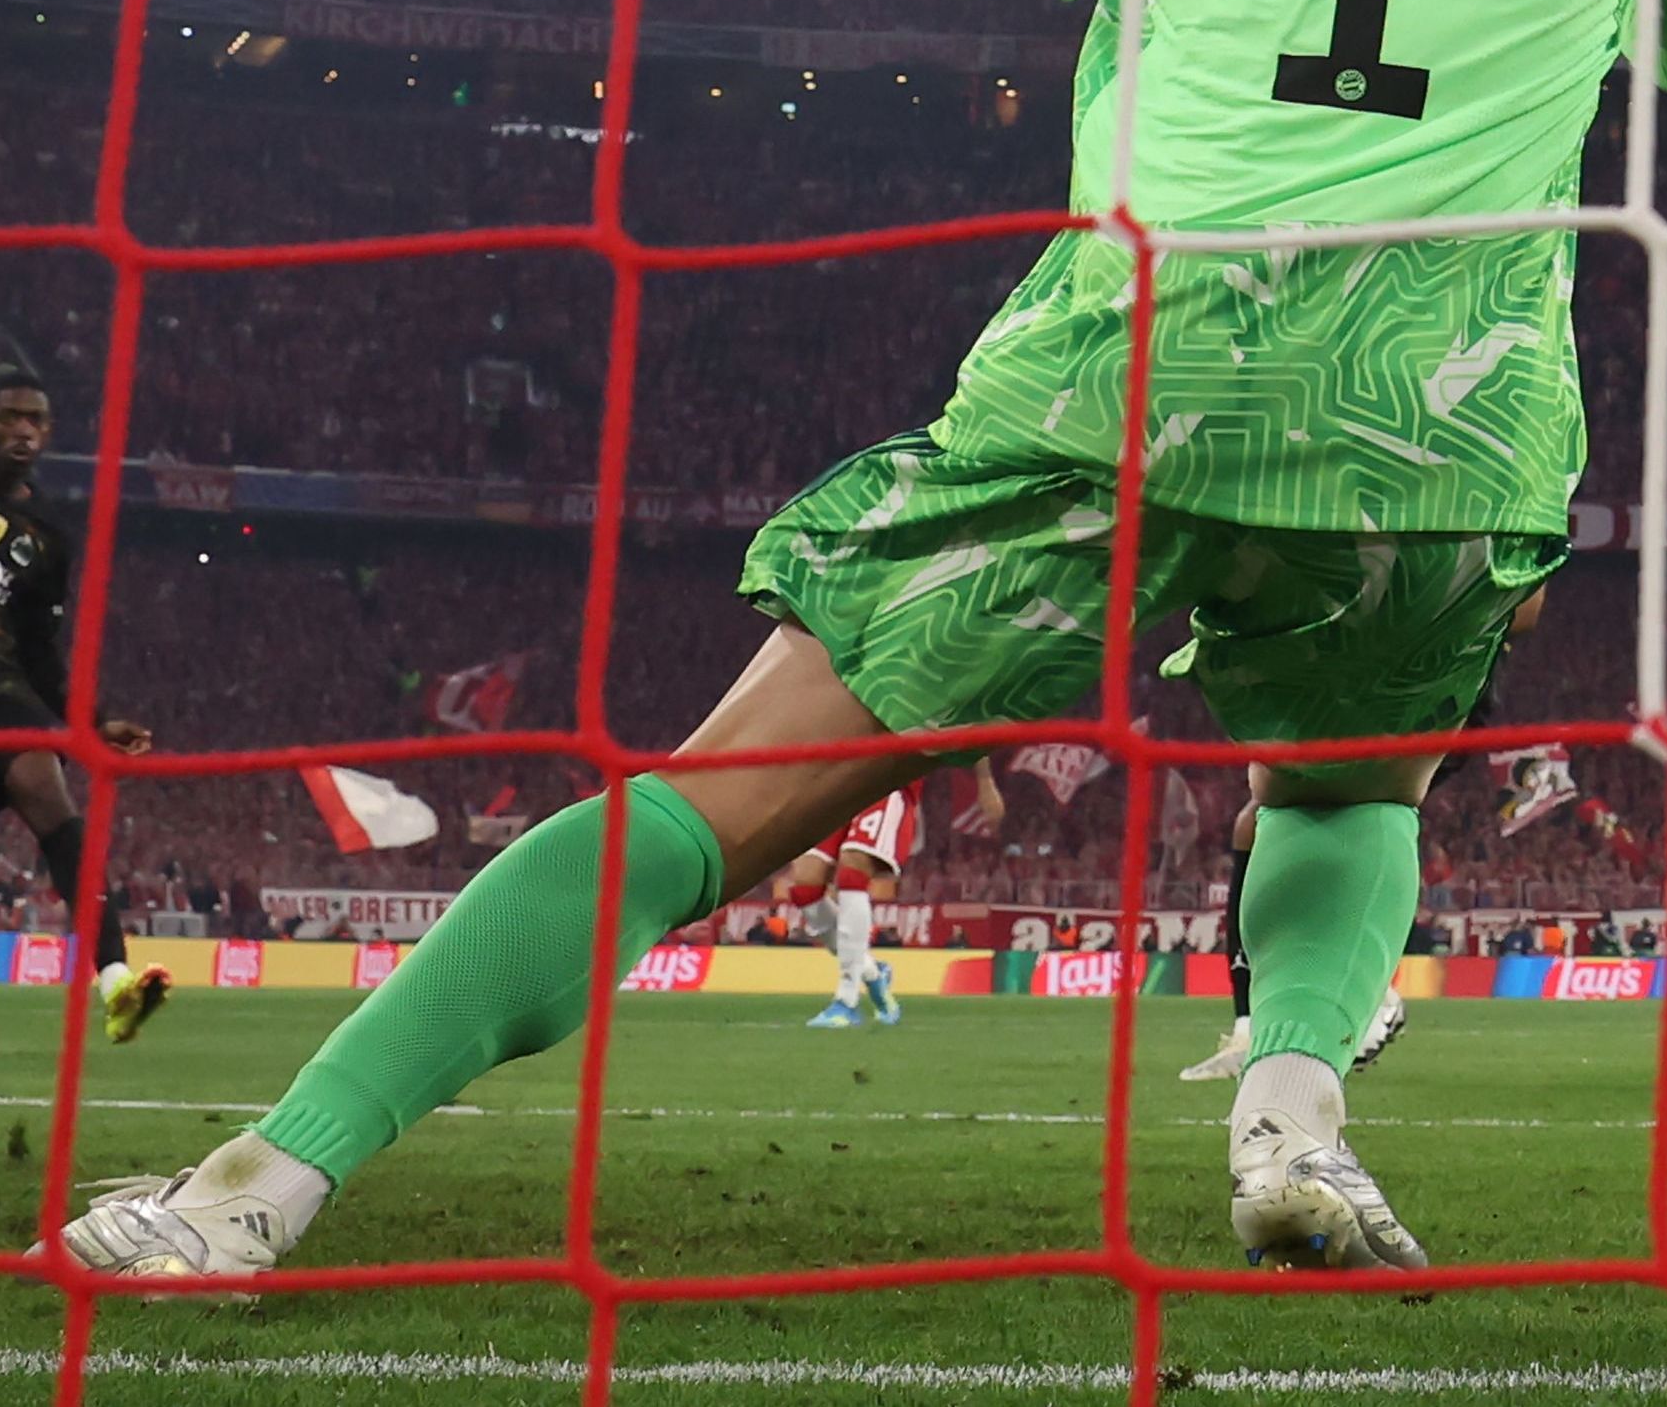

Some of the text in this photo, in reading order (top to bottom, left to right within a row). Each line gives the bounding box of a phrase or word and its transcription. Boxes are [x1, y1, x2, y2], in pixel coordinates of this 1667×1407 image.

[846, 809, 884, 840] 4
[619, 945, 702, 981] ay's
[1555, 955, 1643, 999] Lay's
